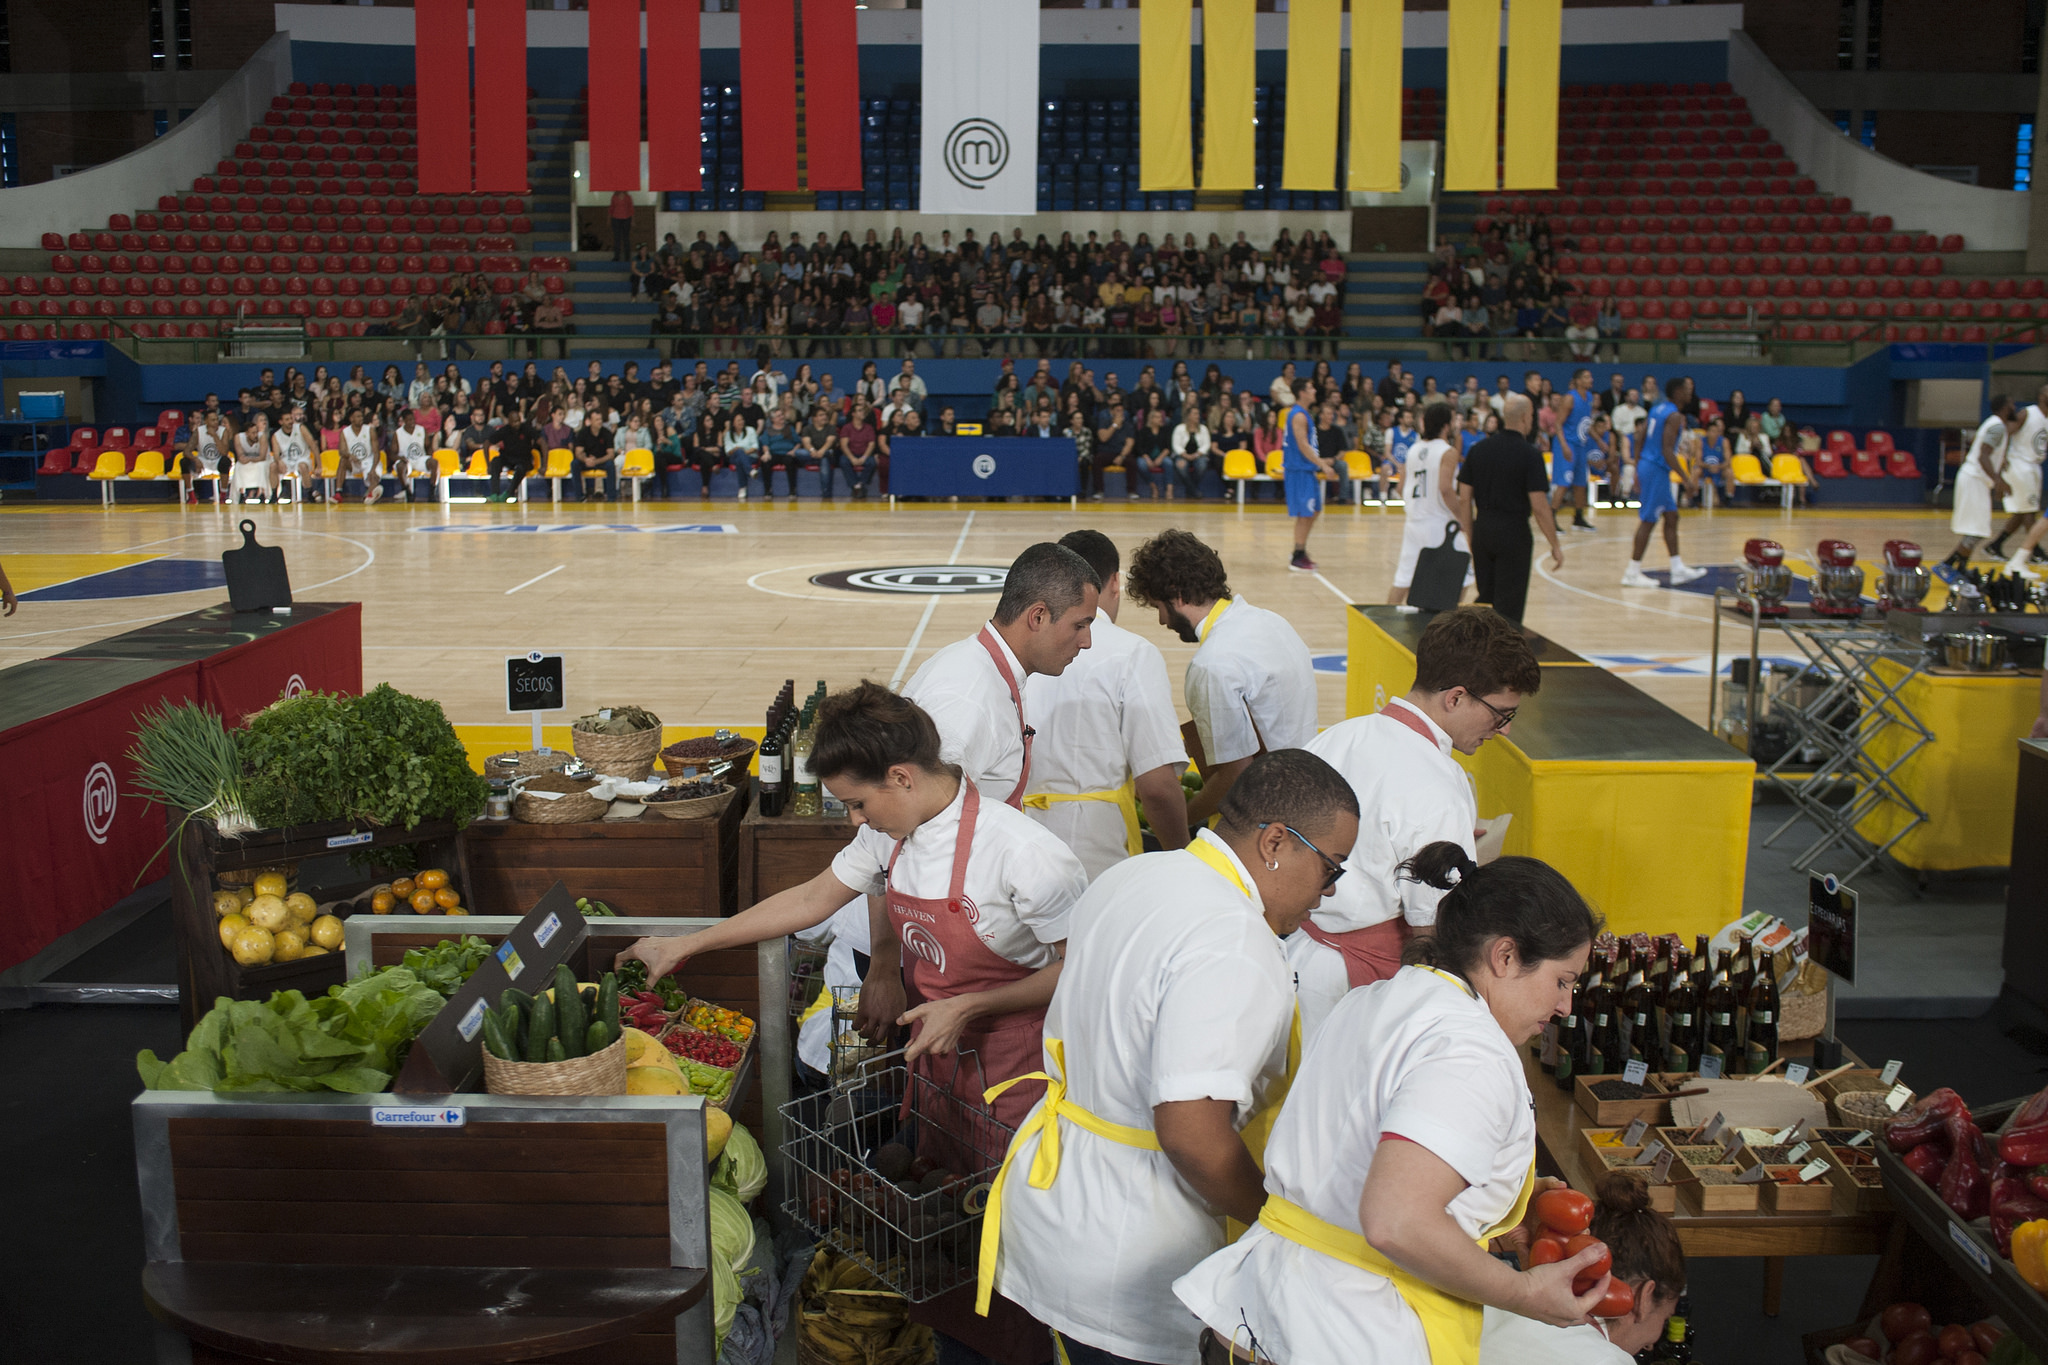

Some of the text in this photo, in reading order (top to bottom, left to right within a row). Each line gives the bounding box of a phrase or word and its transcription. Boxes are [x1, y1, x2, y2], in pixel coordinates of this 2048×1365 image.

[516, 677, 553, 692] SECOS
[329, 837, 359, 846] Carrefour
[893, 904, 936, 924] HEAVEN
[376, 1111, 436, 1122] Carrefour
